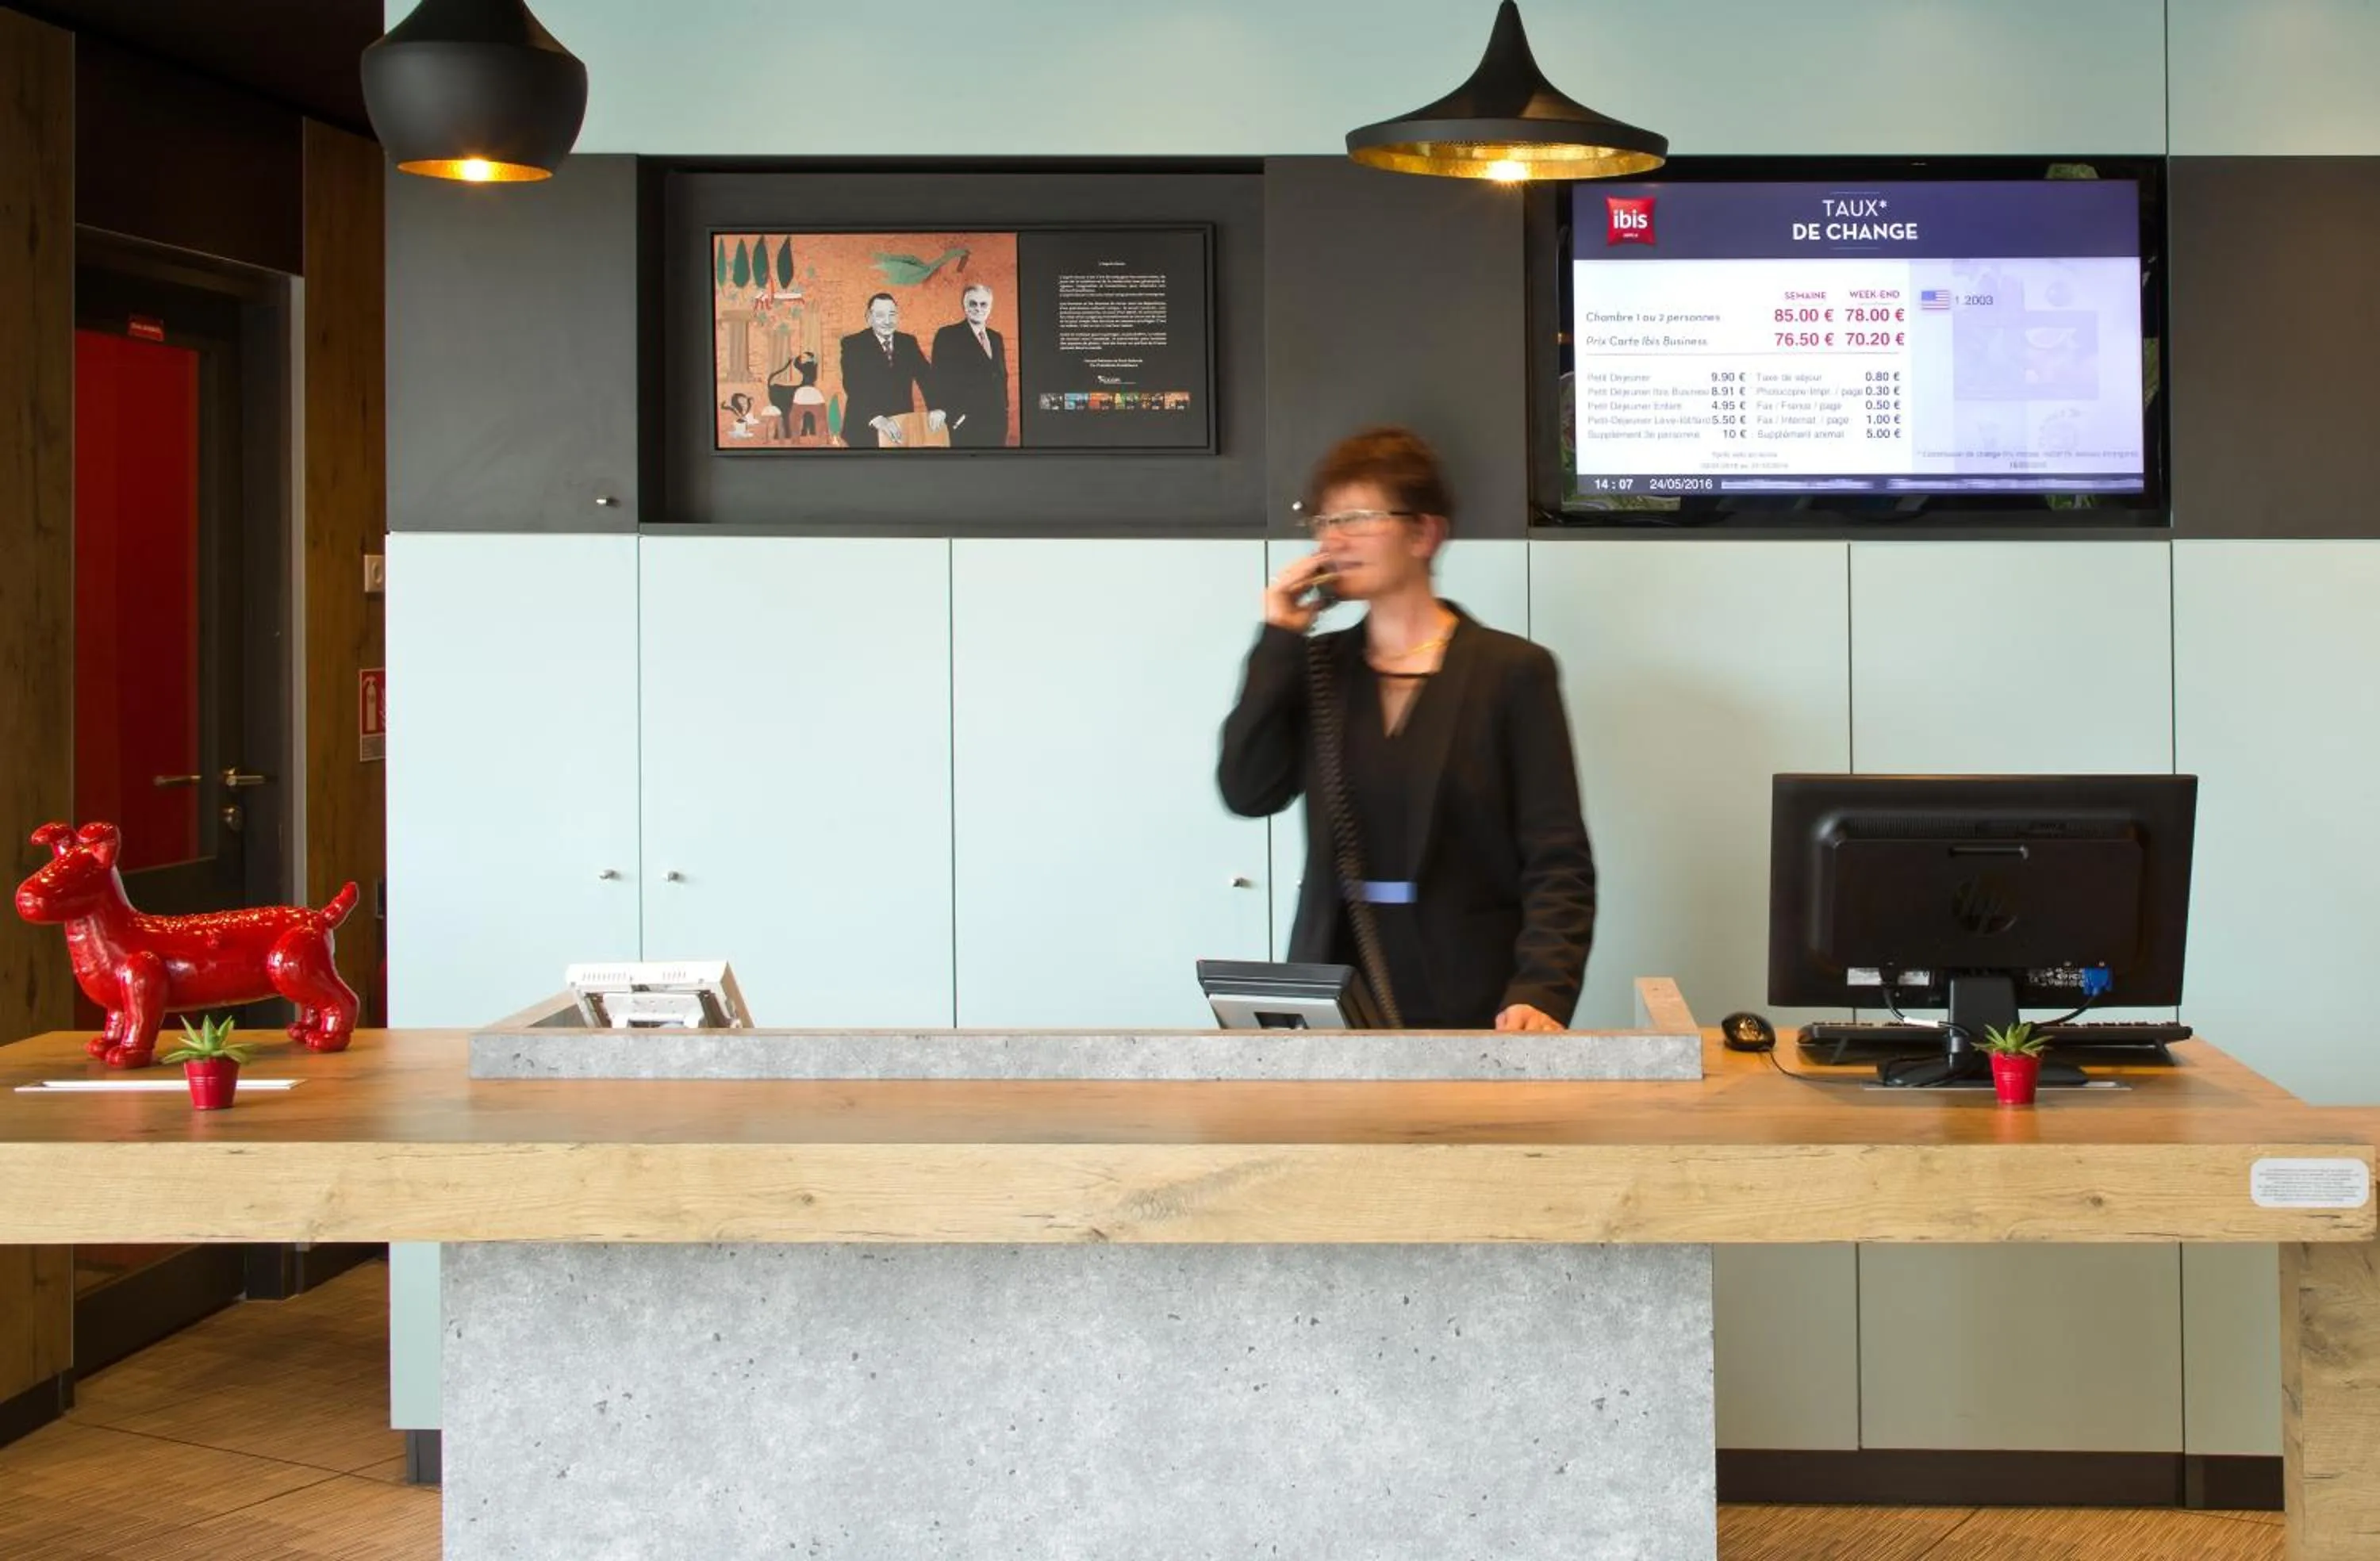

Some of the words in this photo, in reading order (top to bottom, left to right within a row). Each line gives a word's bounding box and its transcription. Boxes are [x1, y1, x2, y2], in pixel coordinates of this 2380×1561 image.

[1613, 209, 1648, 228] ibis
[1793, 223, 1820, 240] DE
[1826, 223, 1917, 240] CHANGE
[1785, 291, 1827, 300] SEMAINE
[1586, 312, 1633, 322] Chambre
[1666, 314, 1721, 324] personnes
[1774, 308, 1819, 322] 85.00
[1824, 308, 1834, 322] €
[1844, 308, 1890, 322] 78.00
[1894, 308, 1905, 322] €
[1586, 336, 1606, 346] Prix
[1609, 336, 1639, 346] Carte
[1663, 336, 1707, 346] Business
[1774, 332, 1819, 346] 76.50
[1824, 332, 1834, 346] €
[1844, 332, 1890, 346] 70.20
[1894, 332, 1905, 346] €
[1710, 372, 1735, 382] 9.90
[1739, 372, 1746, 382] €
[1865, 371, 1889, 381] 0.80
[1894, 371, 1900, 381] €
[1711, 386, 1735, 396] 8.91
[1739, 386, 1746, 396] €
[1865, 386, 1889, 396] 0.30
[1894, 386, 1900, 396] €
[1711, 401, 1735, 410] 4.95
[1740, 401, 1746, 410] €
[1865, 400, 1890, 409] 0.50
[1894, 400, 1901, 409] €
[1711, 415, 1736, 424] 5.50
[1740, 415, 1746, 424] €
[1866, 414, 1890, 424] 1.00
[1894, 414, 1901, 424] €
[1723, 429, 1736, 439] 10
[1740, 429, 1747, 439] €
[1866, 429, 1890, 439] 5.00
[1894, 429, 1901, 439] €
[1595, 478, 1609, 489] 14
[1618, 478, 1633, 489] 07
[1649, 478, 1713, 490] 24/05/2016
